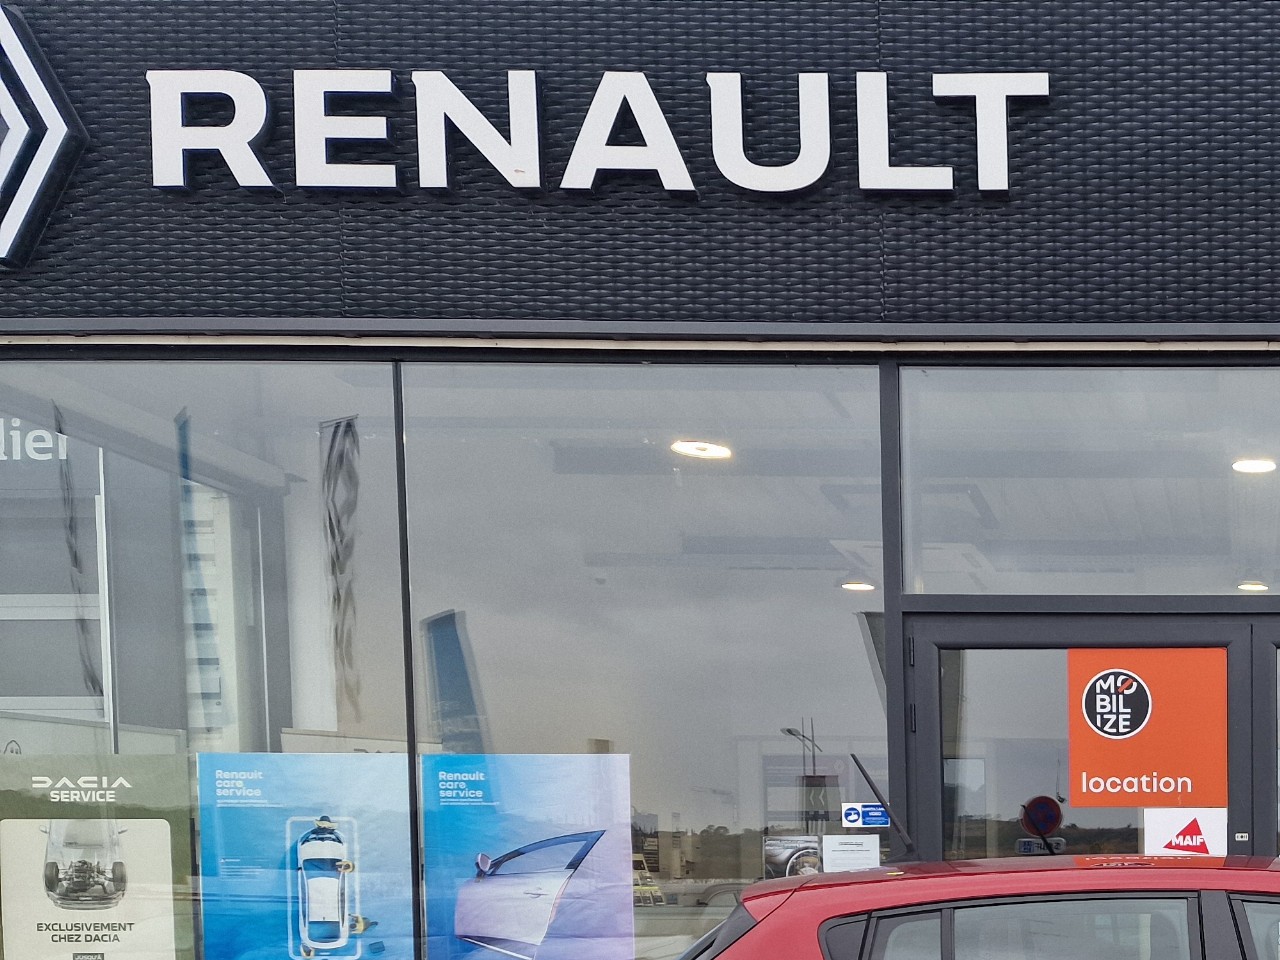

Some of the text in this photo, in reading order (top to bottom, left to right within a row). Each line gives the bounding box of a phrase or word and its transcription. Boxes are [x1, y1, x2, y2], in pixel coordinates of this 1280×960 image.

[145, 69, 1050, 191] RENAULT
[215, 769, 264, 779] Renault
[438, 771, 485, 780] Renault
[31, 776, 132, 788] DACIA
[215, 780, 244, 788] care
[438, 781, 466, 789] care
[1081, 771, 1192, 793] location
[50, 790, 116, 802] SERVICE
[216, 787, 262, 797] service
[439, 788, 483, 797] service
[1171, 835, 1205, 847] MAIF
[36, 922, 135, 932] EXCLUSIVEMENT
[51, 934, 121, 943] CHEZ DACIA
